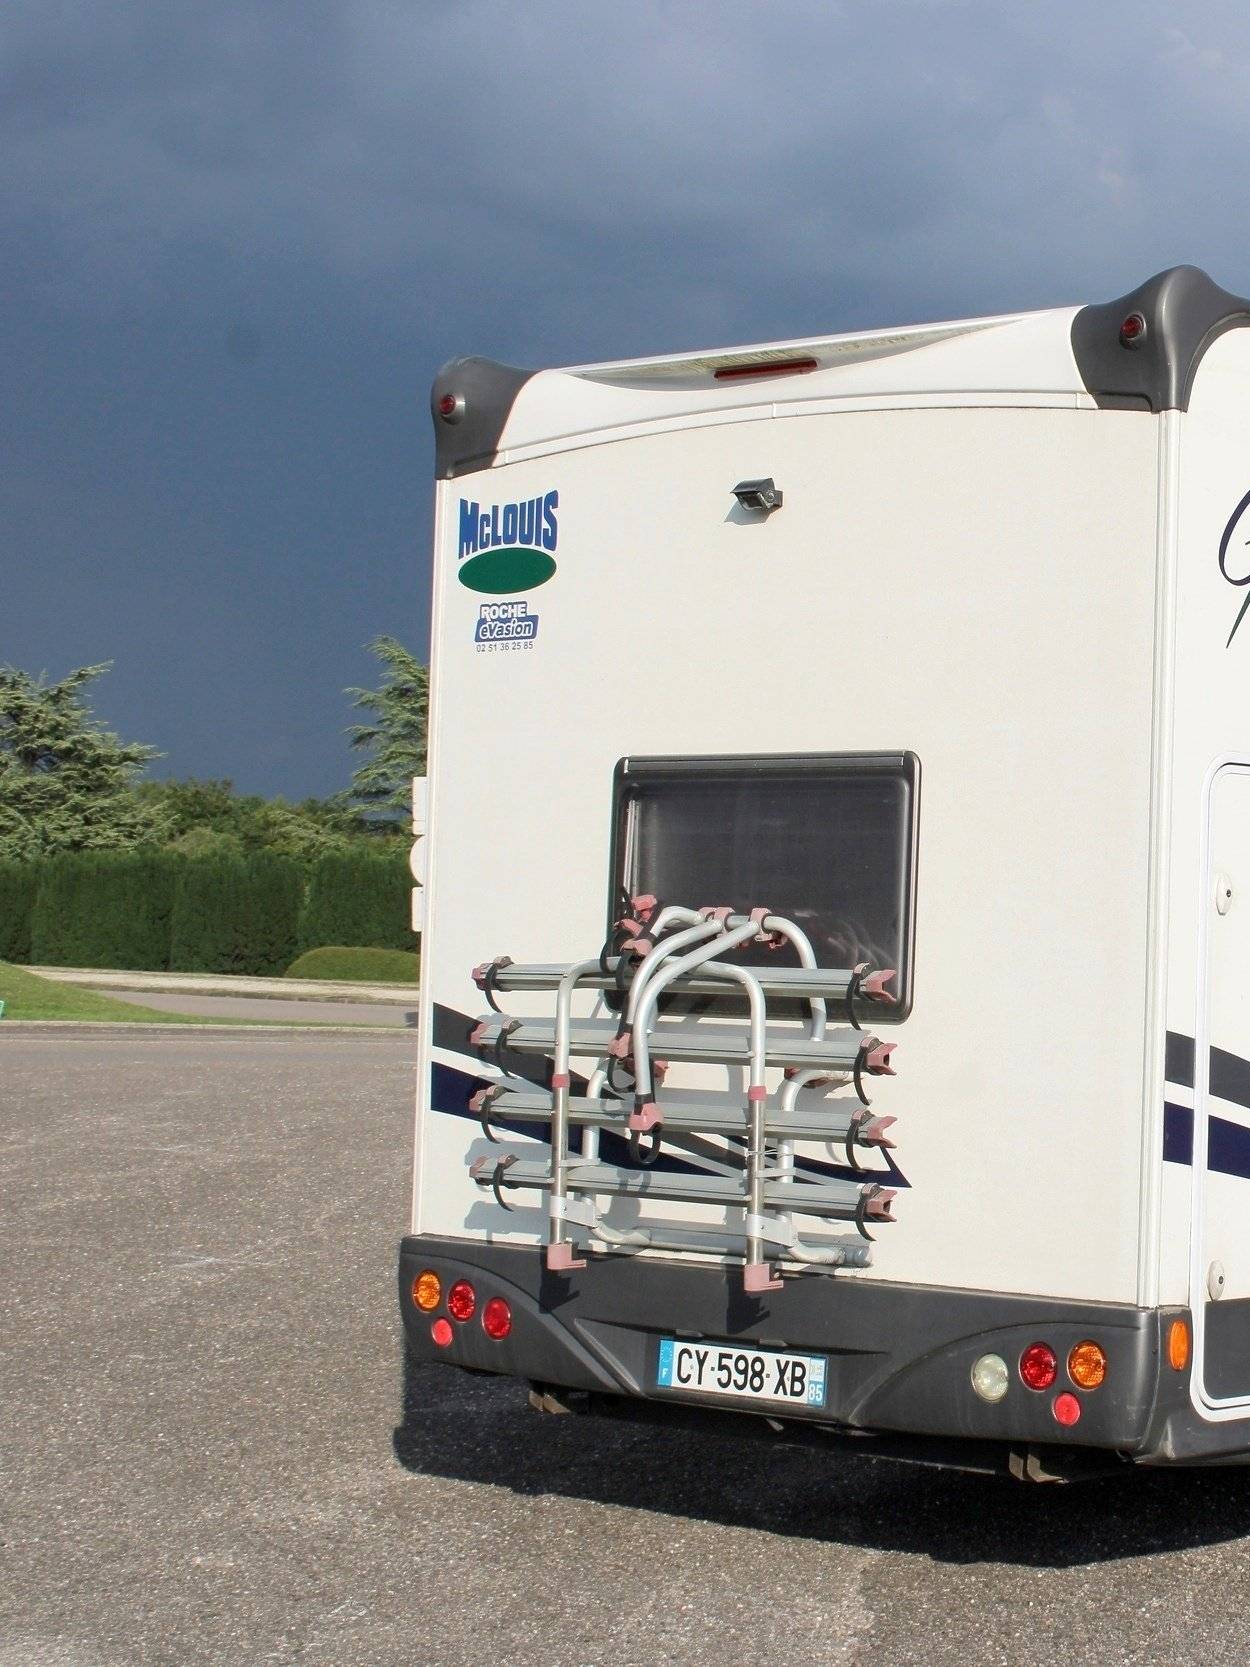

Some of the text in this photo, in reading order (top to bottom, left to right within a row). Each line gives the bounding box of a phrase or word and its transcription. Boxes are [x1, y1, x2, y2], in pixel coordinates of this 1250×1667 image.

[480, 601, 527, 621] ROCHE
[476, 640, 534, 652] 02 51 36 25 85
[808, 1382, 823, 1402] 85
